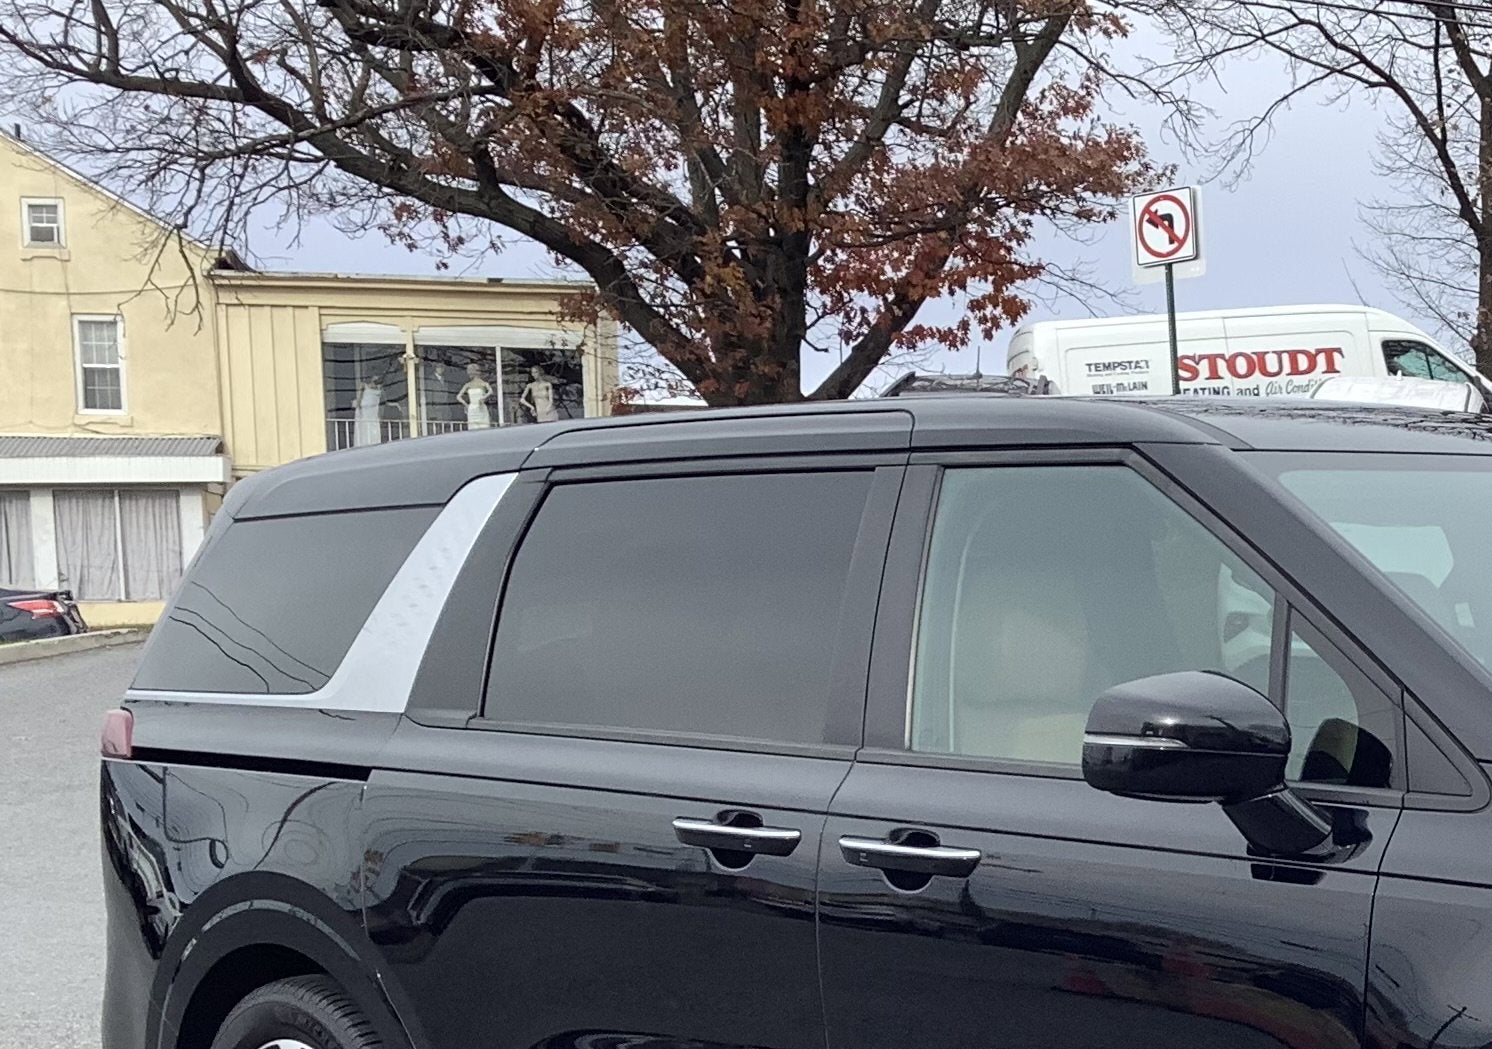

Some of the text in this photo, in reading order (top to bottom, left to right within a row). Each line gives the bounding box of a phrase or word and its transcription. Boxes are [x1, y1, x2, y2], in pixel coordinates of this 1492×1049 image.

[1177, 347, 1345, 382] STOUDT
[1236, 384, 1260, 396] and
[1265, 380, 1283, 396] Air
